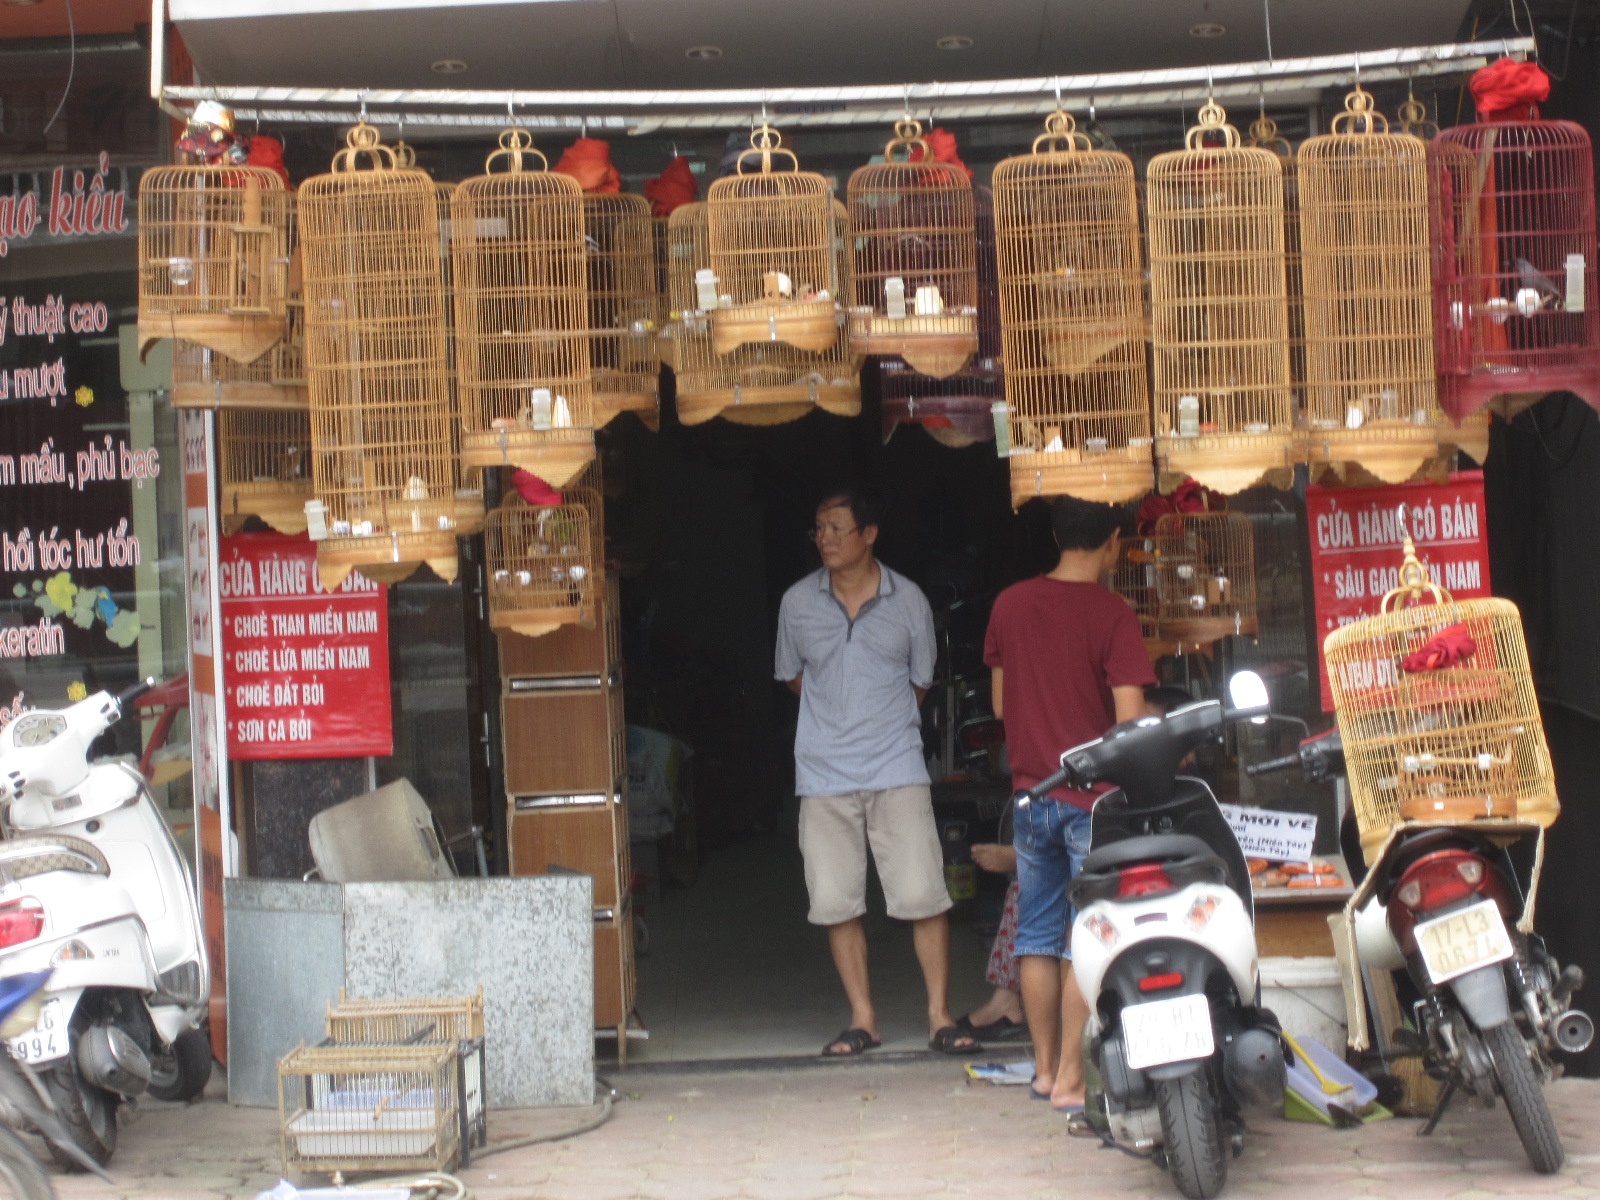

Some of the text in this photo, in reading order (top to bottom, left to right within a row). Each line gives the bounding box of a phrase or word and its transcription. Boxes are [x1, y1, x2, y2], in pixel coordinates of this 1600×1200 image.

[49, 150, 129, 236] kiểu
[12, 294, 65, 343] thuật
[69, 302, 108, 333] cao
[14, 356, 67, 407] mượt
[120, 440, 160, 489] bạc
[3, 516, 141, 572] hồi tóc hư tổn
[1317, 495, 1479, 549] CỬA HÀNG CÓ BÁN
[219, 547, 255, 597] CỬA
[259, 552, 307, 595] HÀNG
[1334, 563, 1364, 599] SÂU
[1445, 560, 1481, 591] NAM
[0, 616, 66, 658] keratin
[234, 610, 269, 638] CHOÈ
[271, 612, 305, 636] THAN
[347, 611, 378, 633] NAM
[235, 640, 370, 673] CHOÈ LỬA MIỀN NAM
[236, 680, 271, 708] CHOÈ
[274, 676, 299, 706] ĐẤT
[237, 718, 264, 743] SƠN
[268, 719, 286, 742] CA
